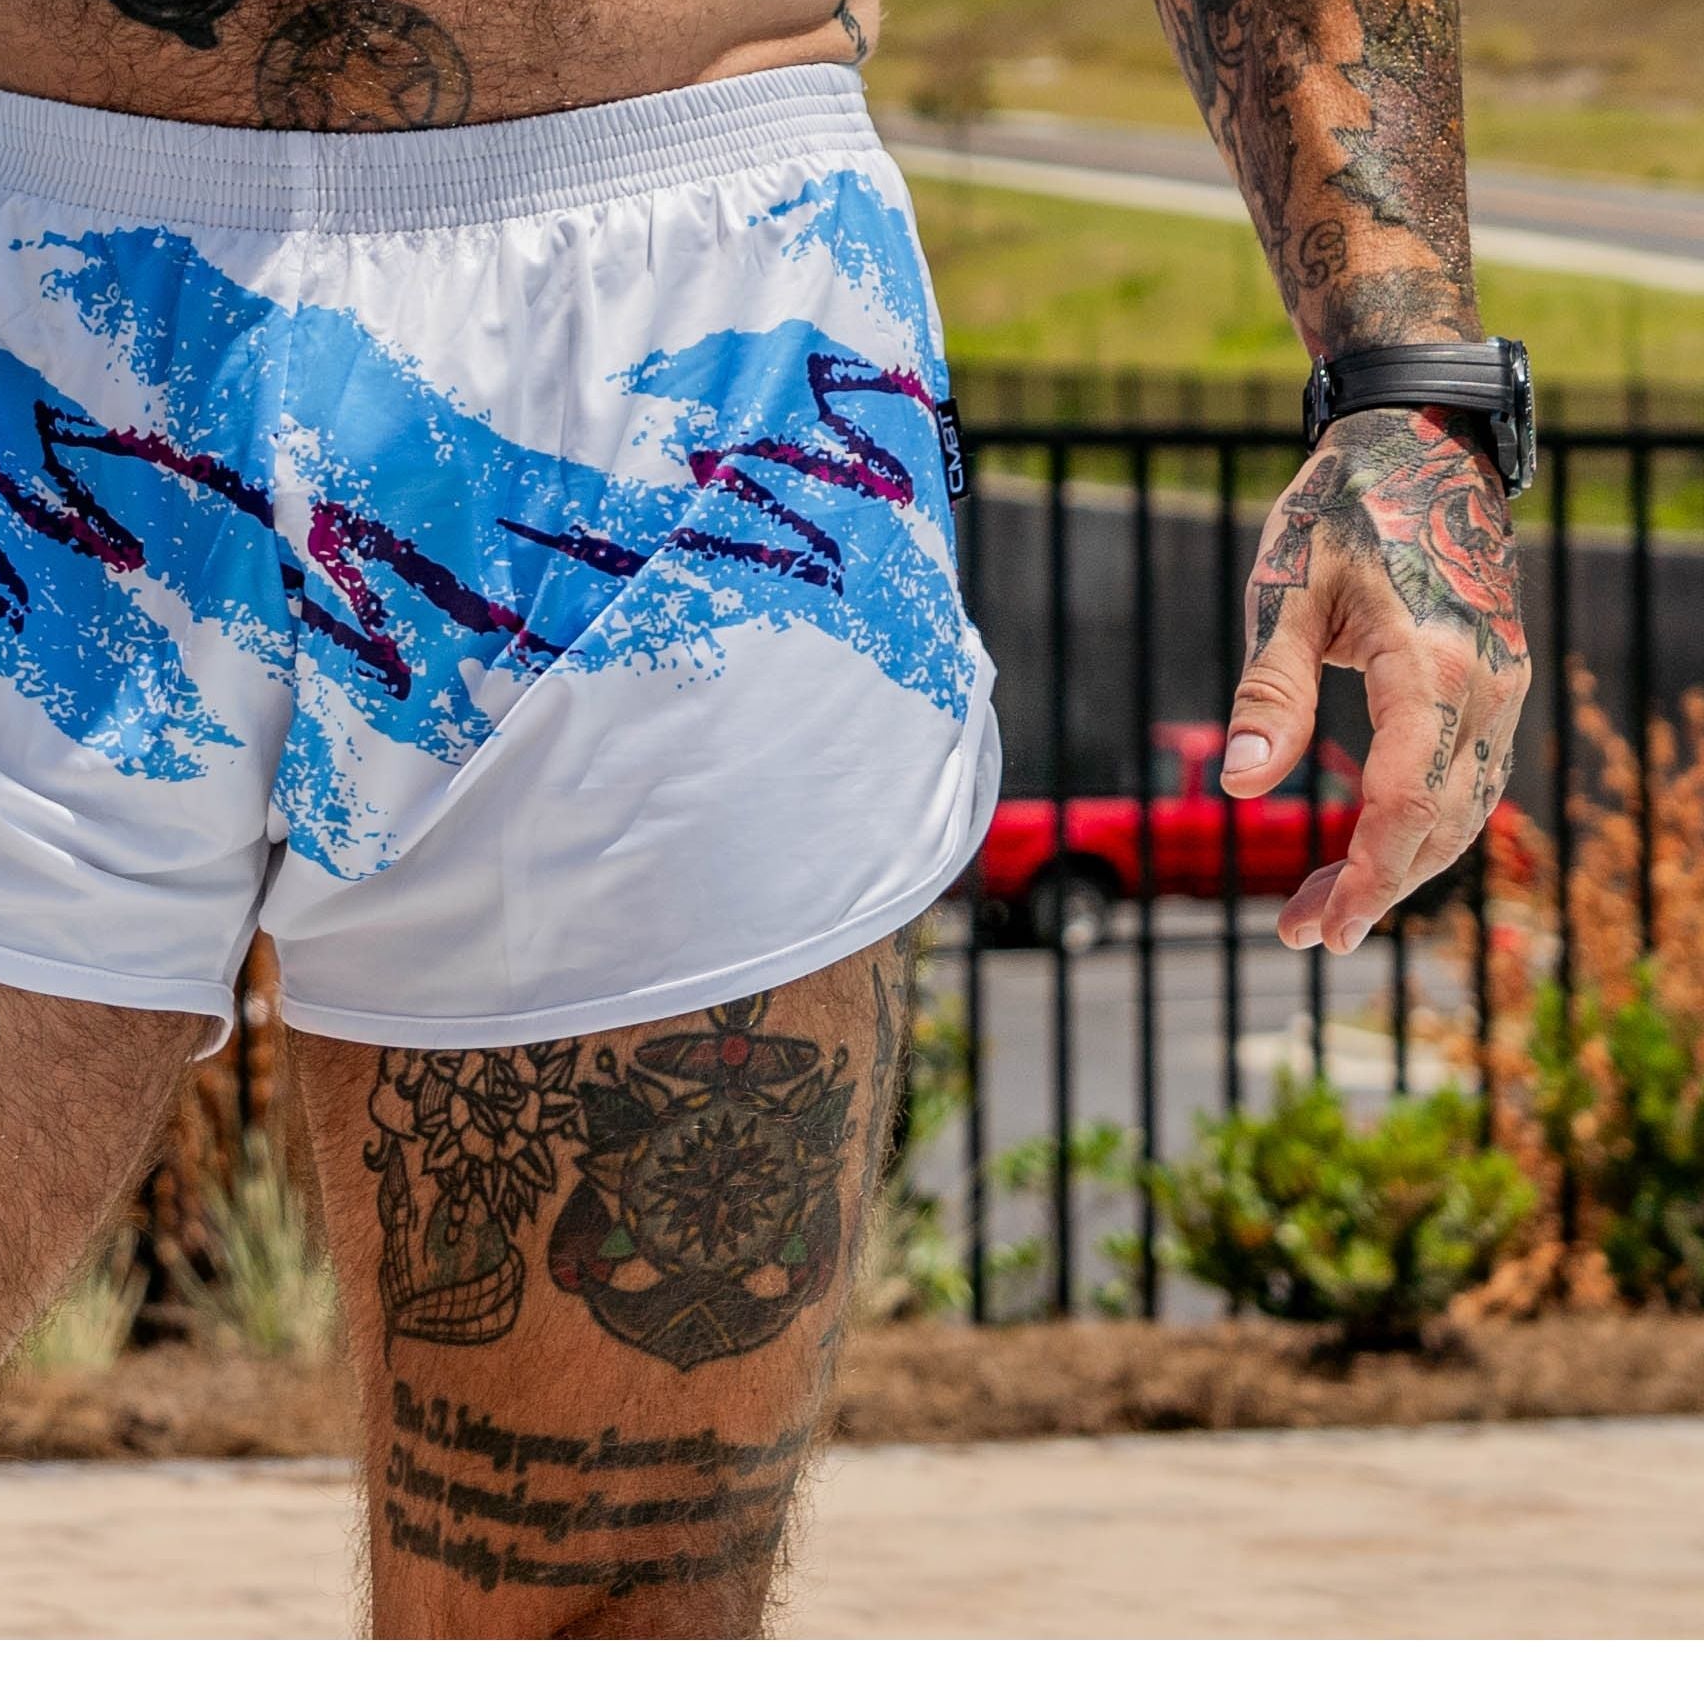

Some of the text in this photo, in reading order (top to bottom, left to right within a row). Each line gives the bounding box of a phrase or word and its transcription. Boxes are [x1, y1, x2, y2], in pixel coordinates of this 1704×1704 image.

[937, 410, 964, 494] CMBT
[1425, 701, 1458, 792] send
[1472, 738, 1490, 801] me
